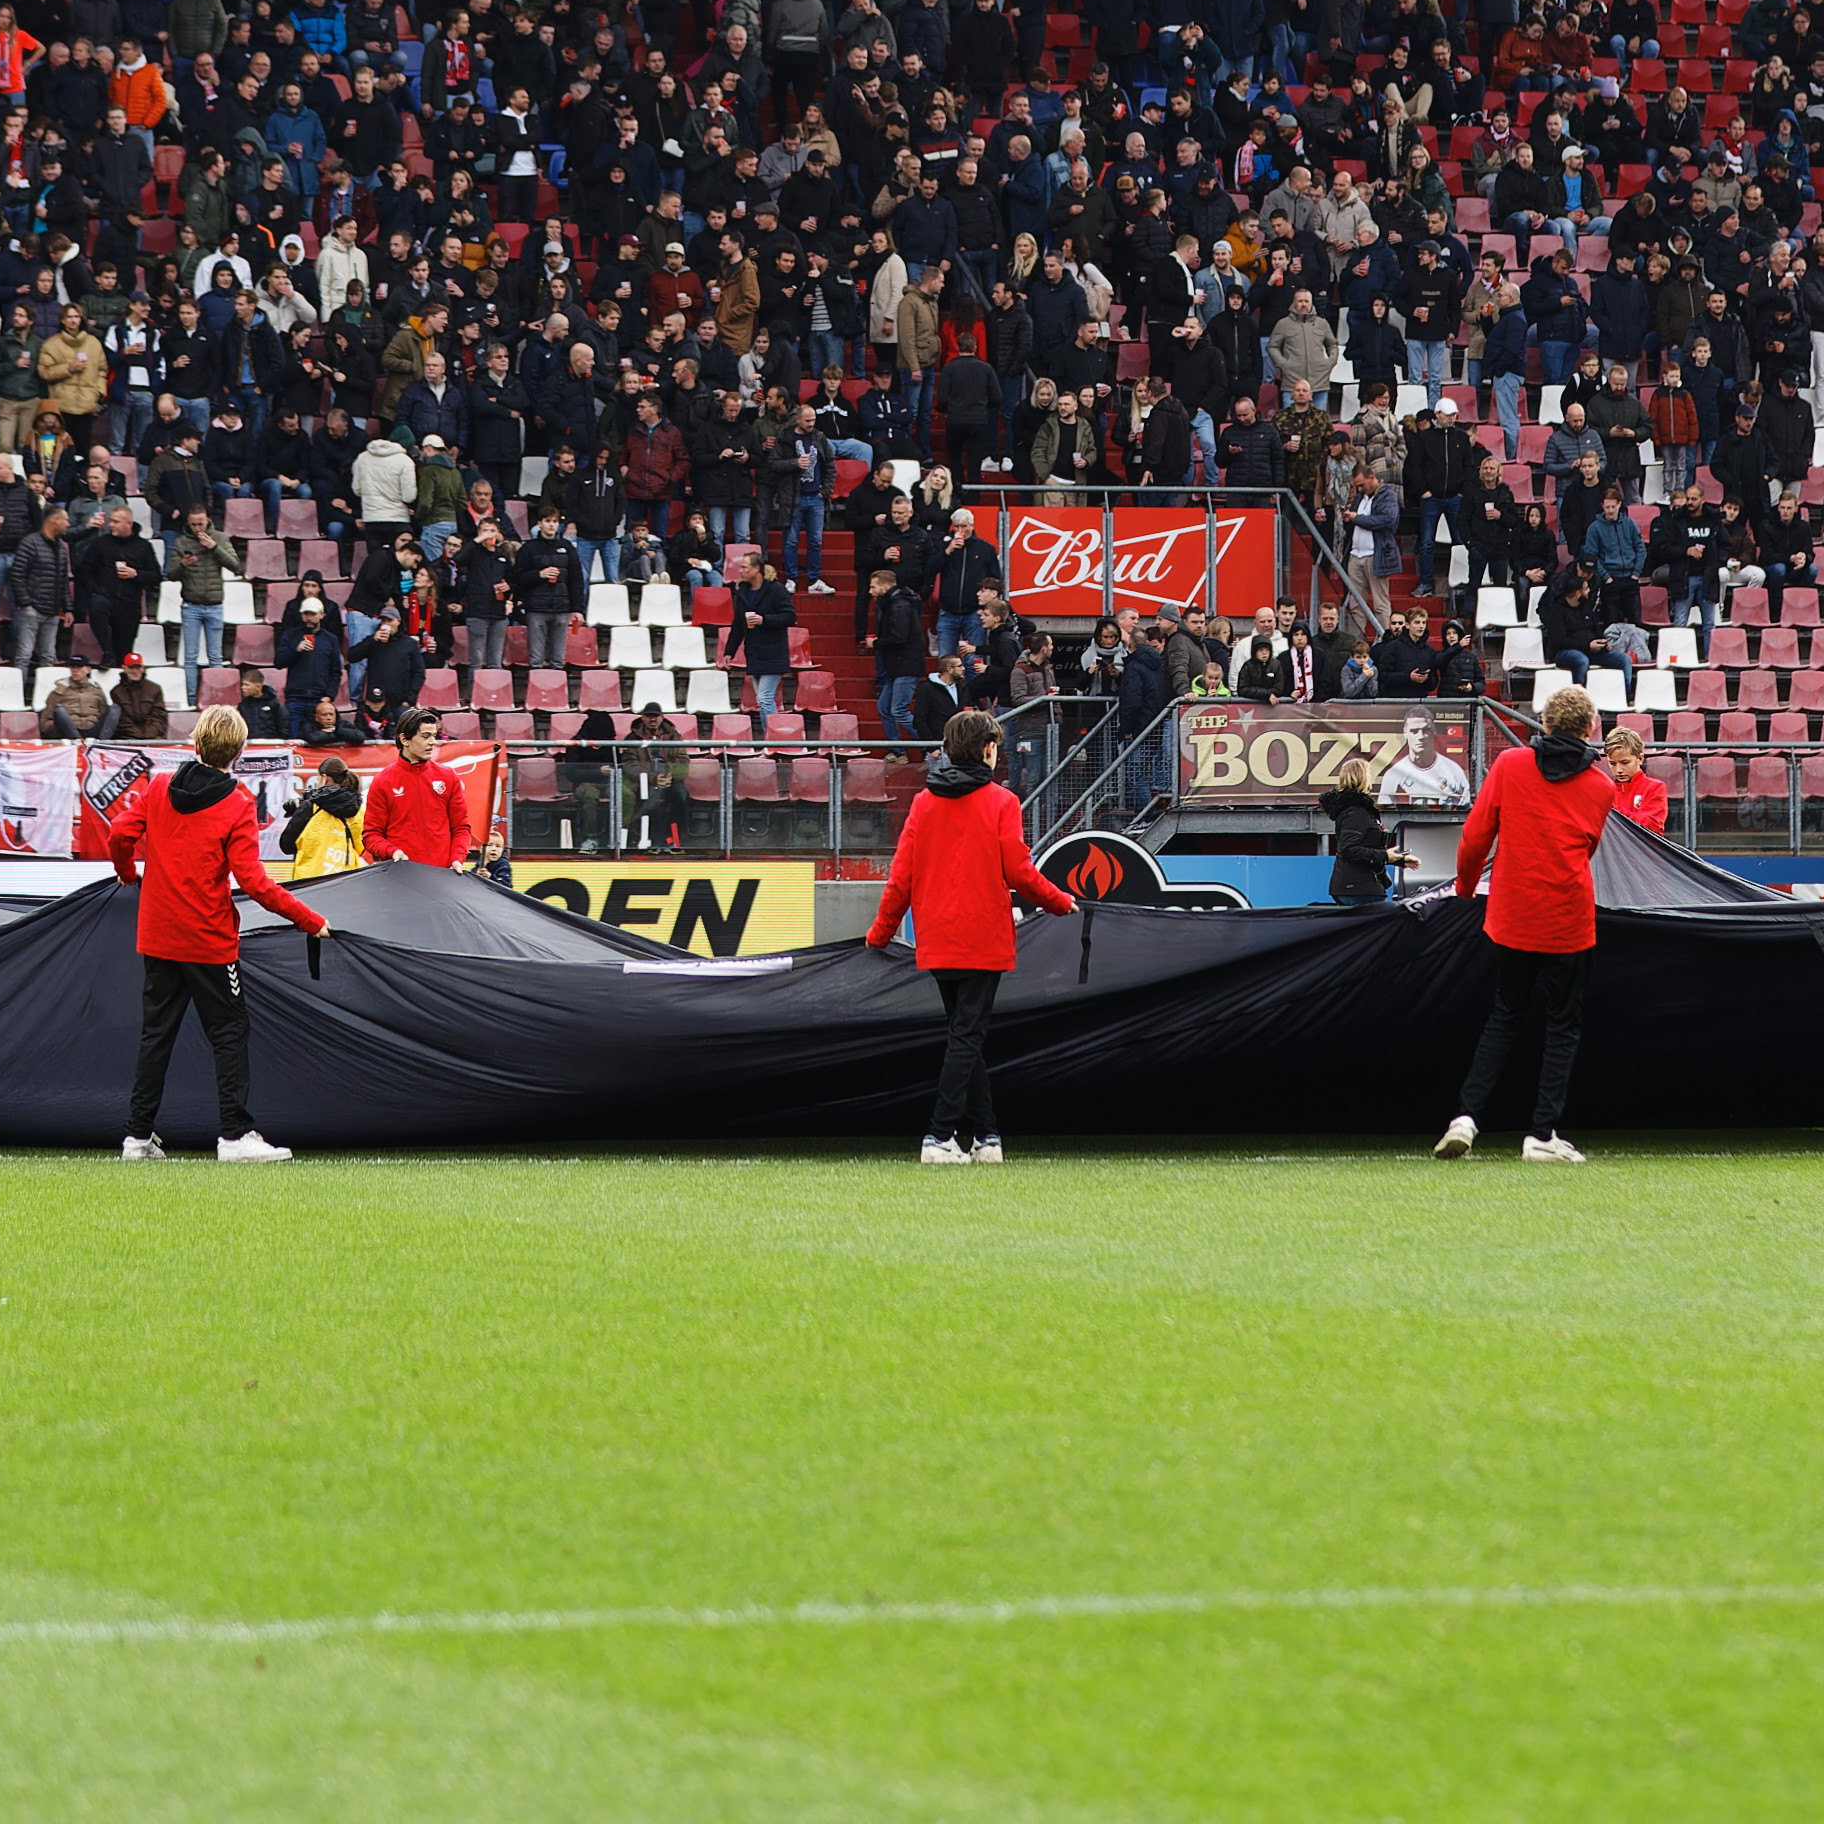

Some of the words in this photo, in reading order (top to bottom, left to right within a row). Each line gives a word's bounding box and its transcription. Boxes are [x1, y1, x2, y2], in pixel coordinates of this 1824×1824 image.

[1023, 527, 1179, 588] Bud
[1188, 714, 1228, 729] THE
[93, 755, 149, 811] UTRECHT
[1188, 730, 1407, 787] BOZZ
